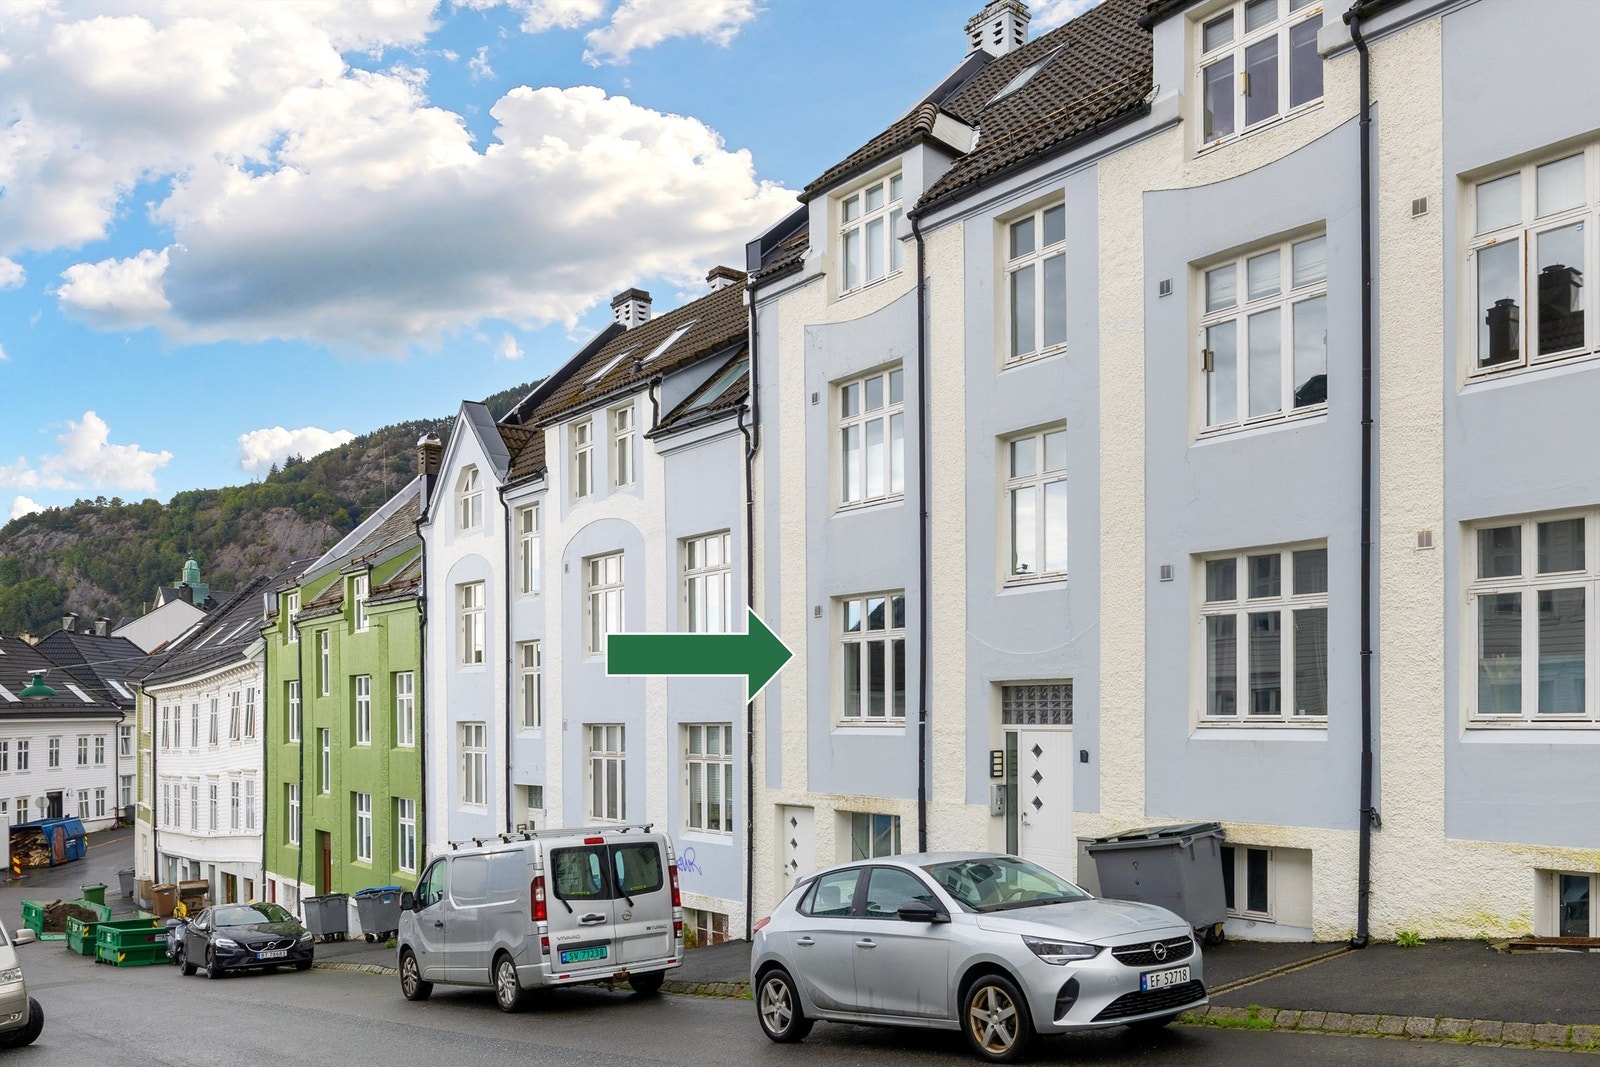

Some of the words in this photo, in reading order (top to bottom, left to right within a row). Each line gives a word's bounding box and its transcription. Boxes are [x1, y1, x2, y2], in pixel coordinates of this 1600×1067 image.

[569, 951, 579, 961] SV
[581, 948, 605, 959] 71238
[1150, 974, 1160, 988] EF
[1164, 968, 1188, 986] 52718
